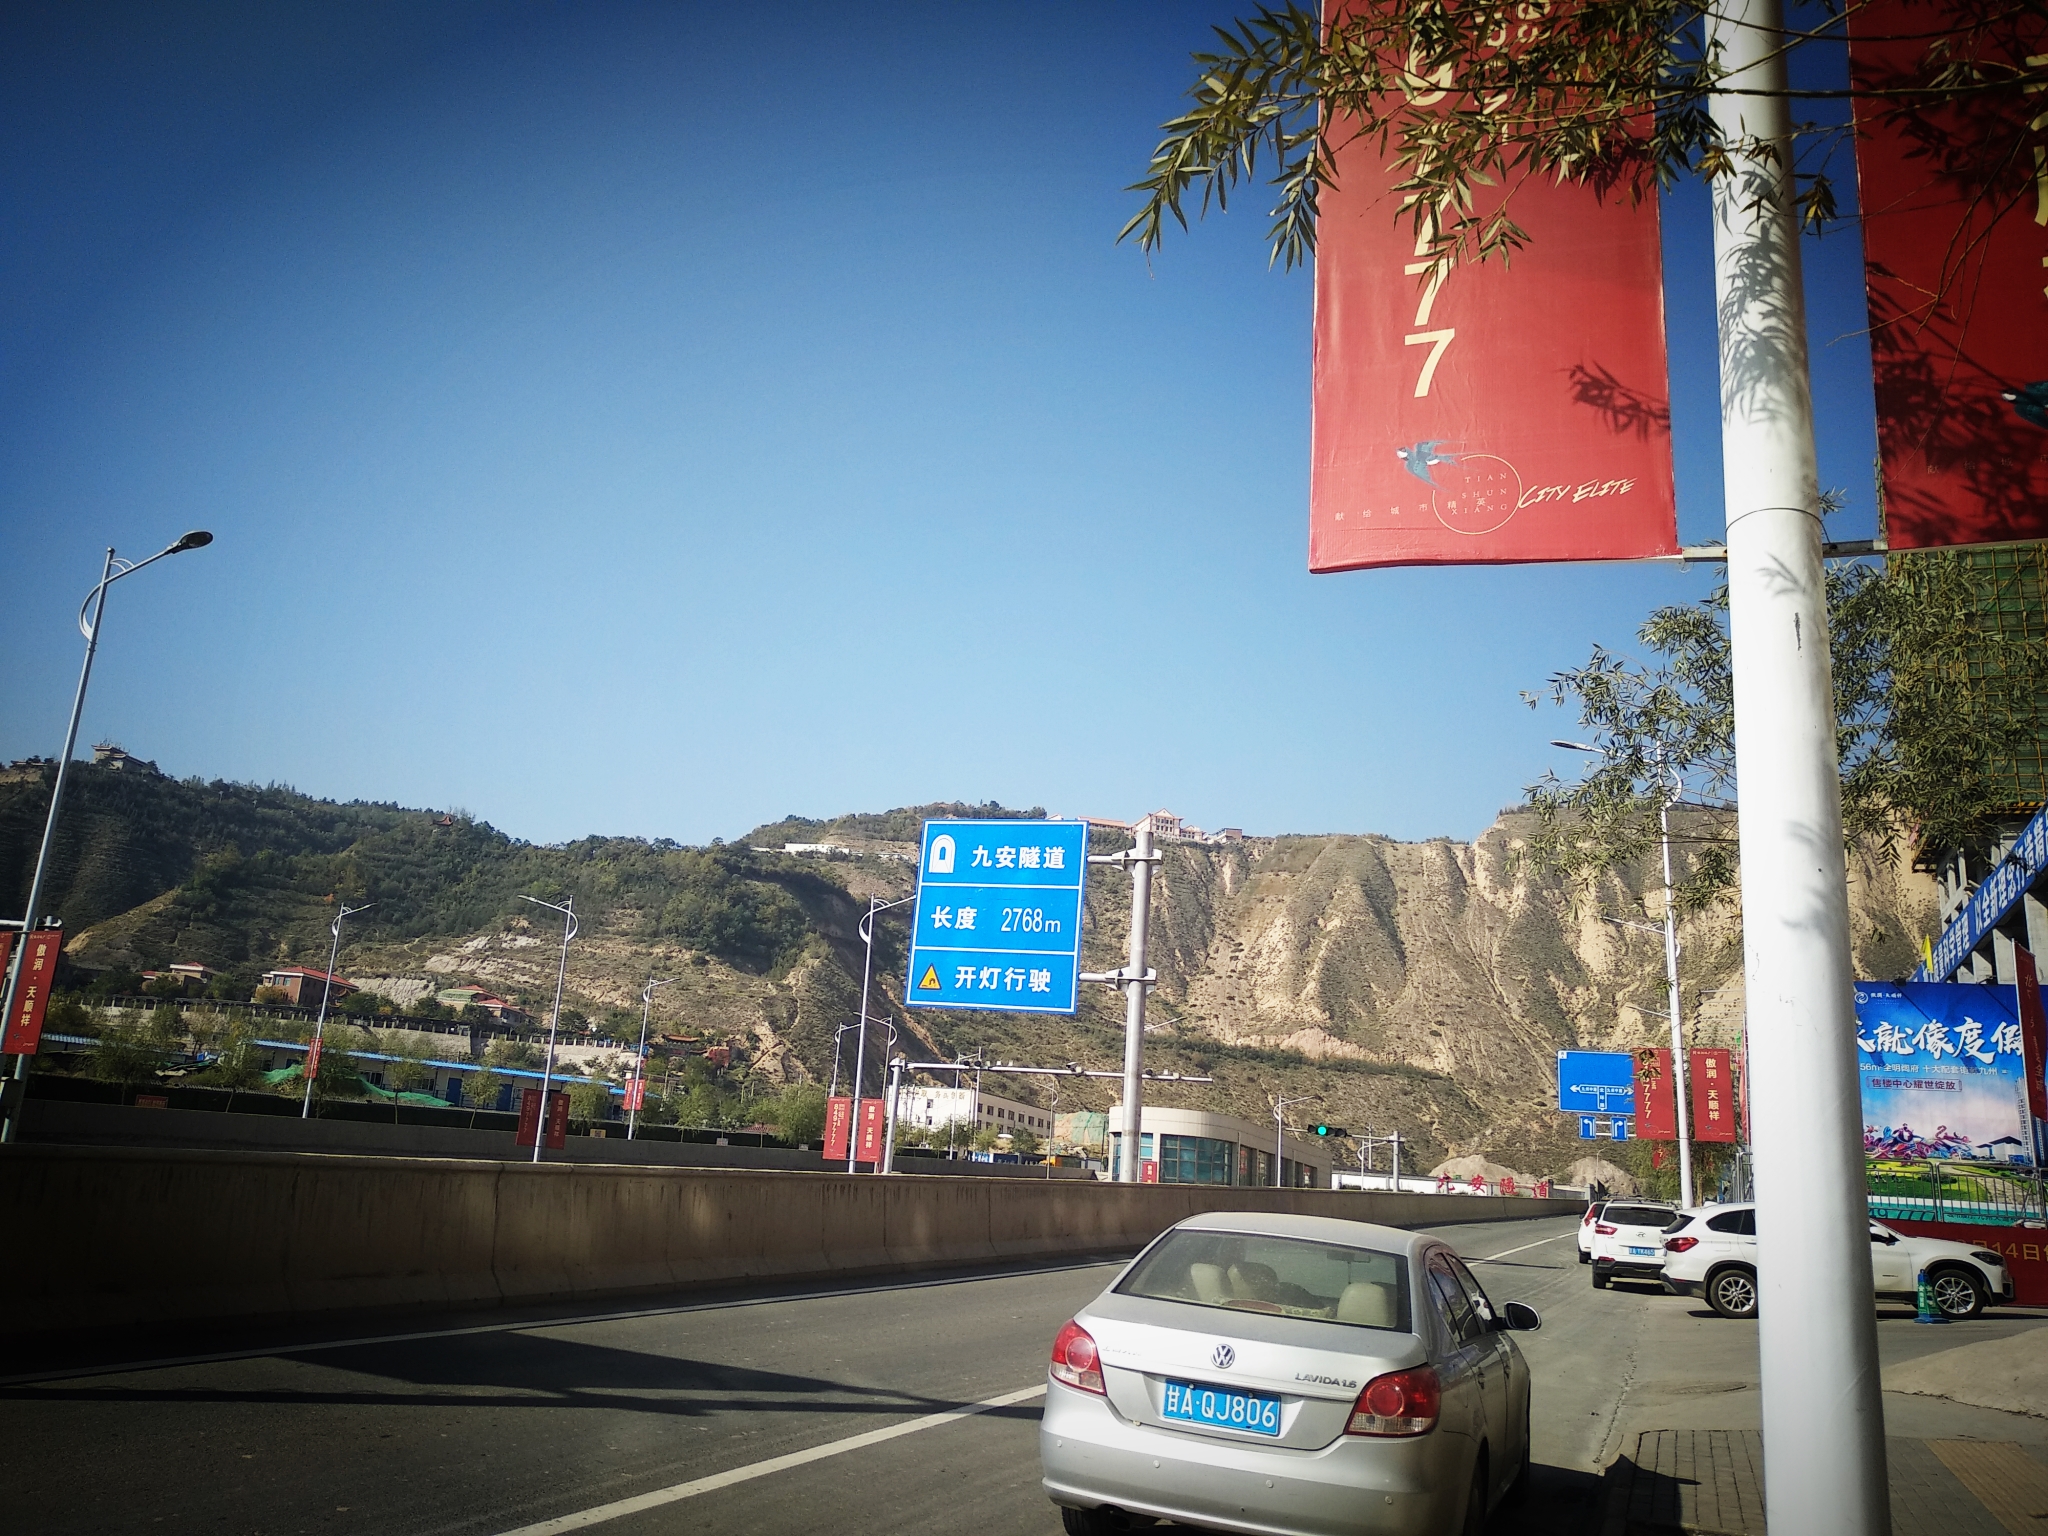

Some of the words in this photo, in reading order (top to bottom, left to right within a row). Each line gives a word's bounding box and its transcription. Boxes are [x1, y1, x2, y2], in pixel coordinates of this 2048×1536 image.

[1464, 473, 1508, 484] TIAN
[1461, 488, 1508, 499] SHUN
[1518, 484, 1571, 509] CITY
[1572, 477, 1637, 503] ELITE
[1451, 504, 1509, 516] XIANG
[971, 845, 1066, 869] 九安隧道
[1974, 808, 2048, 936] 以全新理念打造精
[931, 906, 977, 930] 长度
[1001, 907, 1061, 933] 2768m
[954, 966, 1051, 992] 开灯行驶
[1437, 1171, 1549, 1199] 九安隧道
